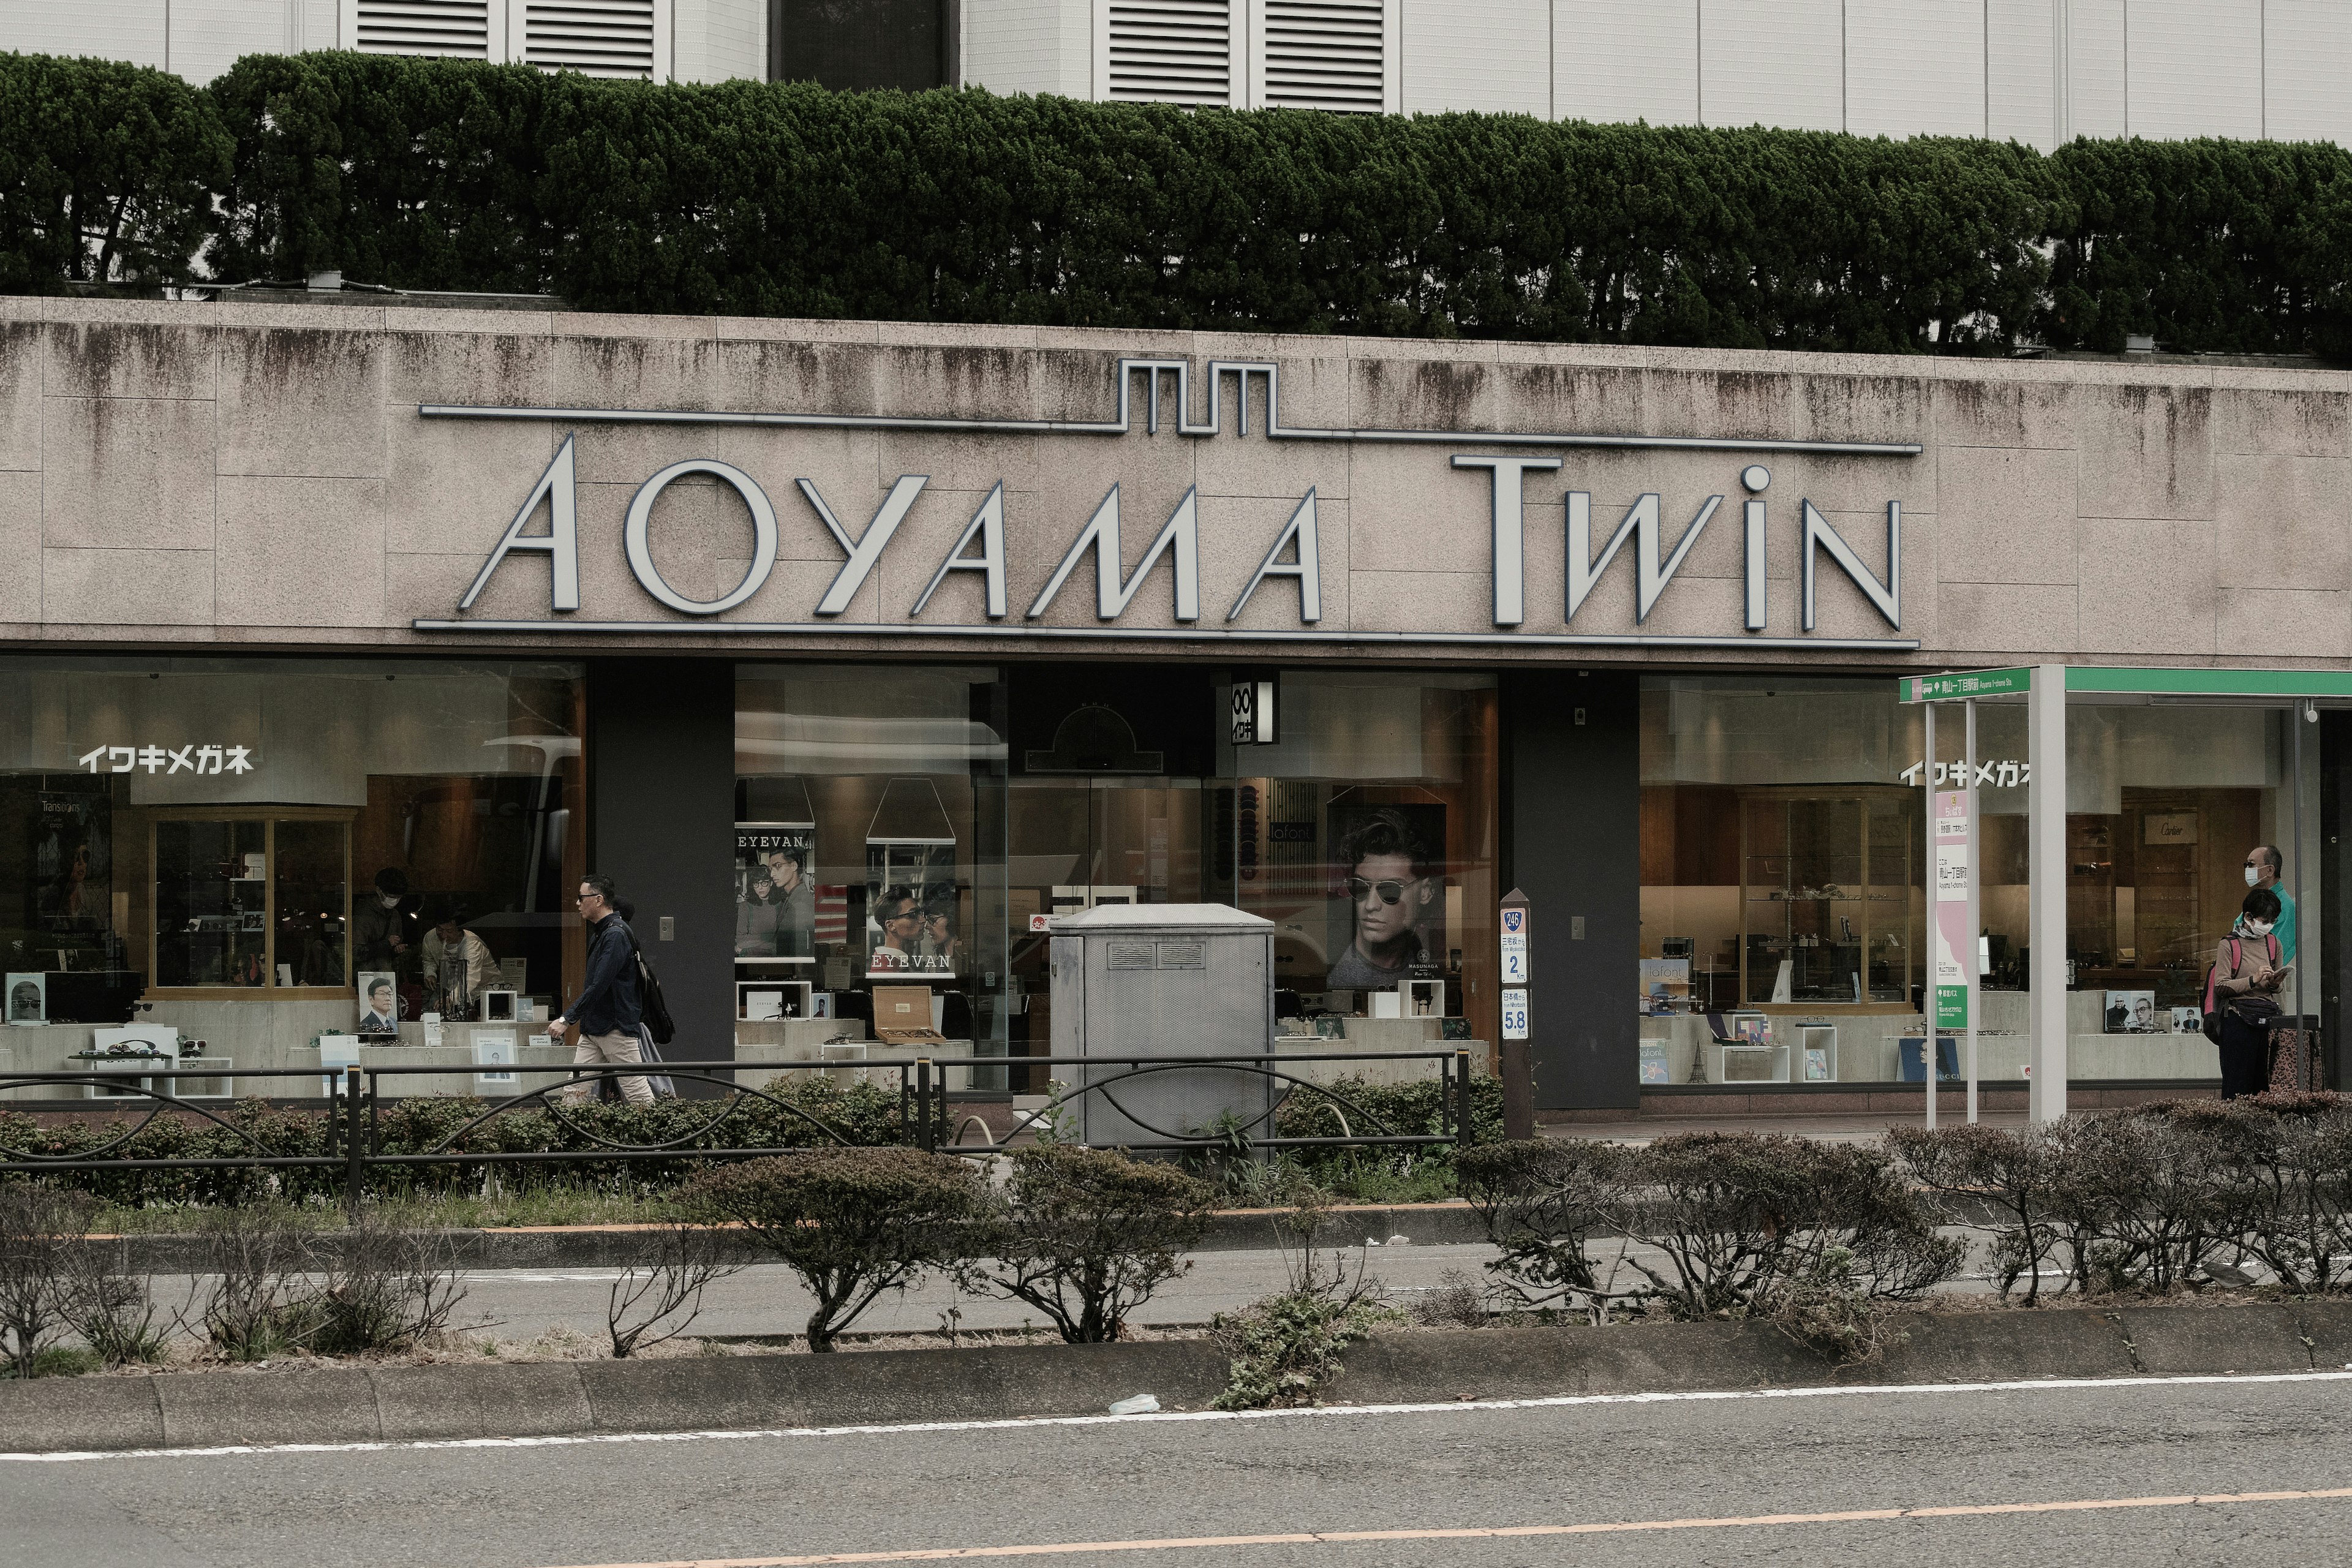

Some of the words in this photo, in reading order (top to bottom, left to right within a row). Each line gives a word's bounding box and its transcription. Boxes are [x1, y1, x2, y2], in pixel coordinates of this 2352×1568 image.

[462, 431, 1322, 623] AOYAMA
[1942, 677, 1979, 694] 青山一丁目駅前
[1232, 719, 1251, 740] イワキ
[78, 744, 254, 775] イワキメガネ
[42, 800, 80, 813] Transitions
[1271, 824, 1310, 839] lafont
[2160, 822, 2183, 836] Cartier
[738, 837, 803, 846] EYEVAN
[1507, 913, 1519, 926] 246
[1502, 937, 1525, 946] 三宅坂から
[872, 955, 950, 968] EYEVAN
[1510, 956, 1518, 973] 2
[1649, 966, 1682, 978] lafont
[1504, 993, 1526, 1001] 日本橋から
[1505, 1011, 1525, 1030] 5.8
[1640, 1048, 1662, 1057] lafont
